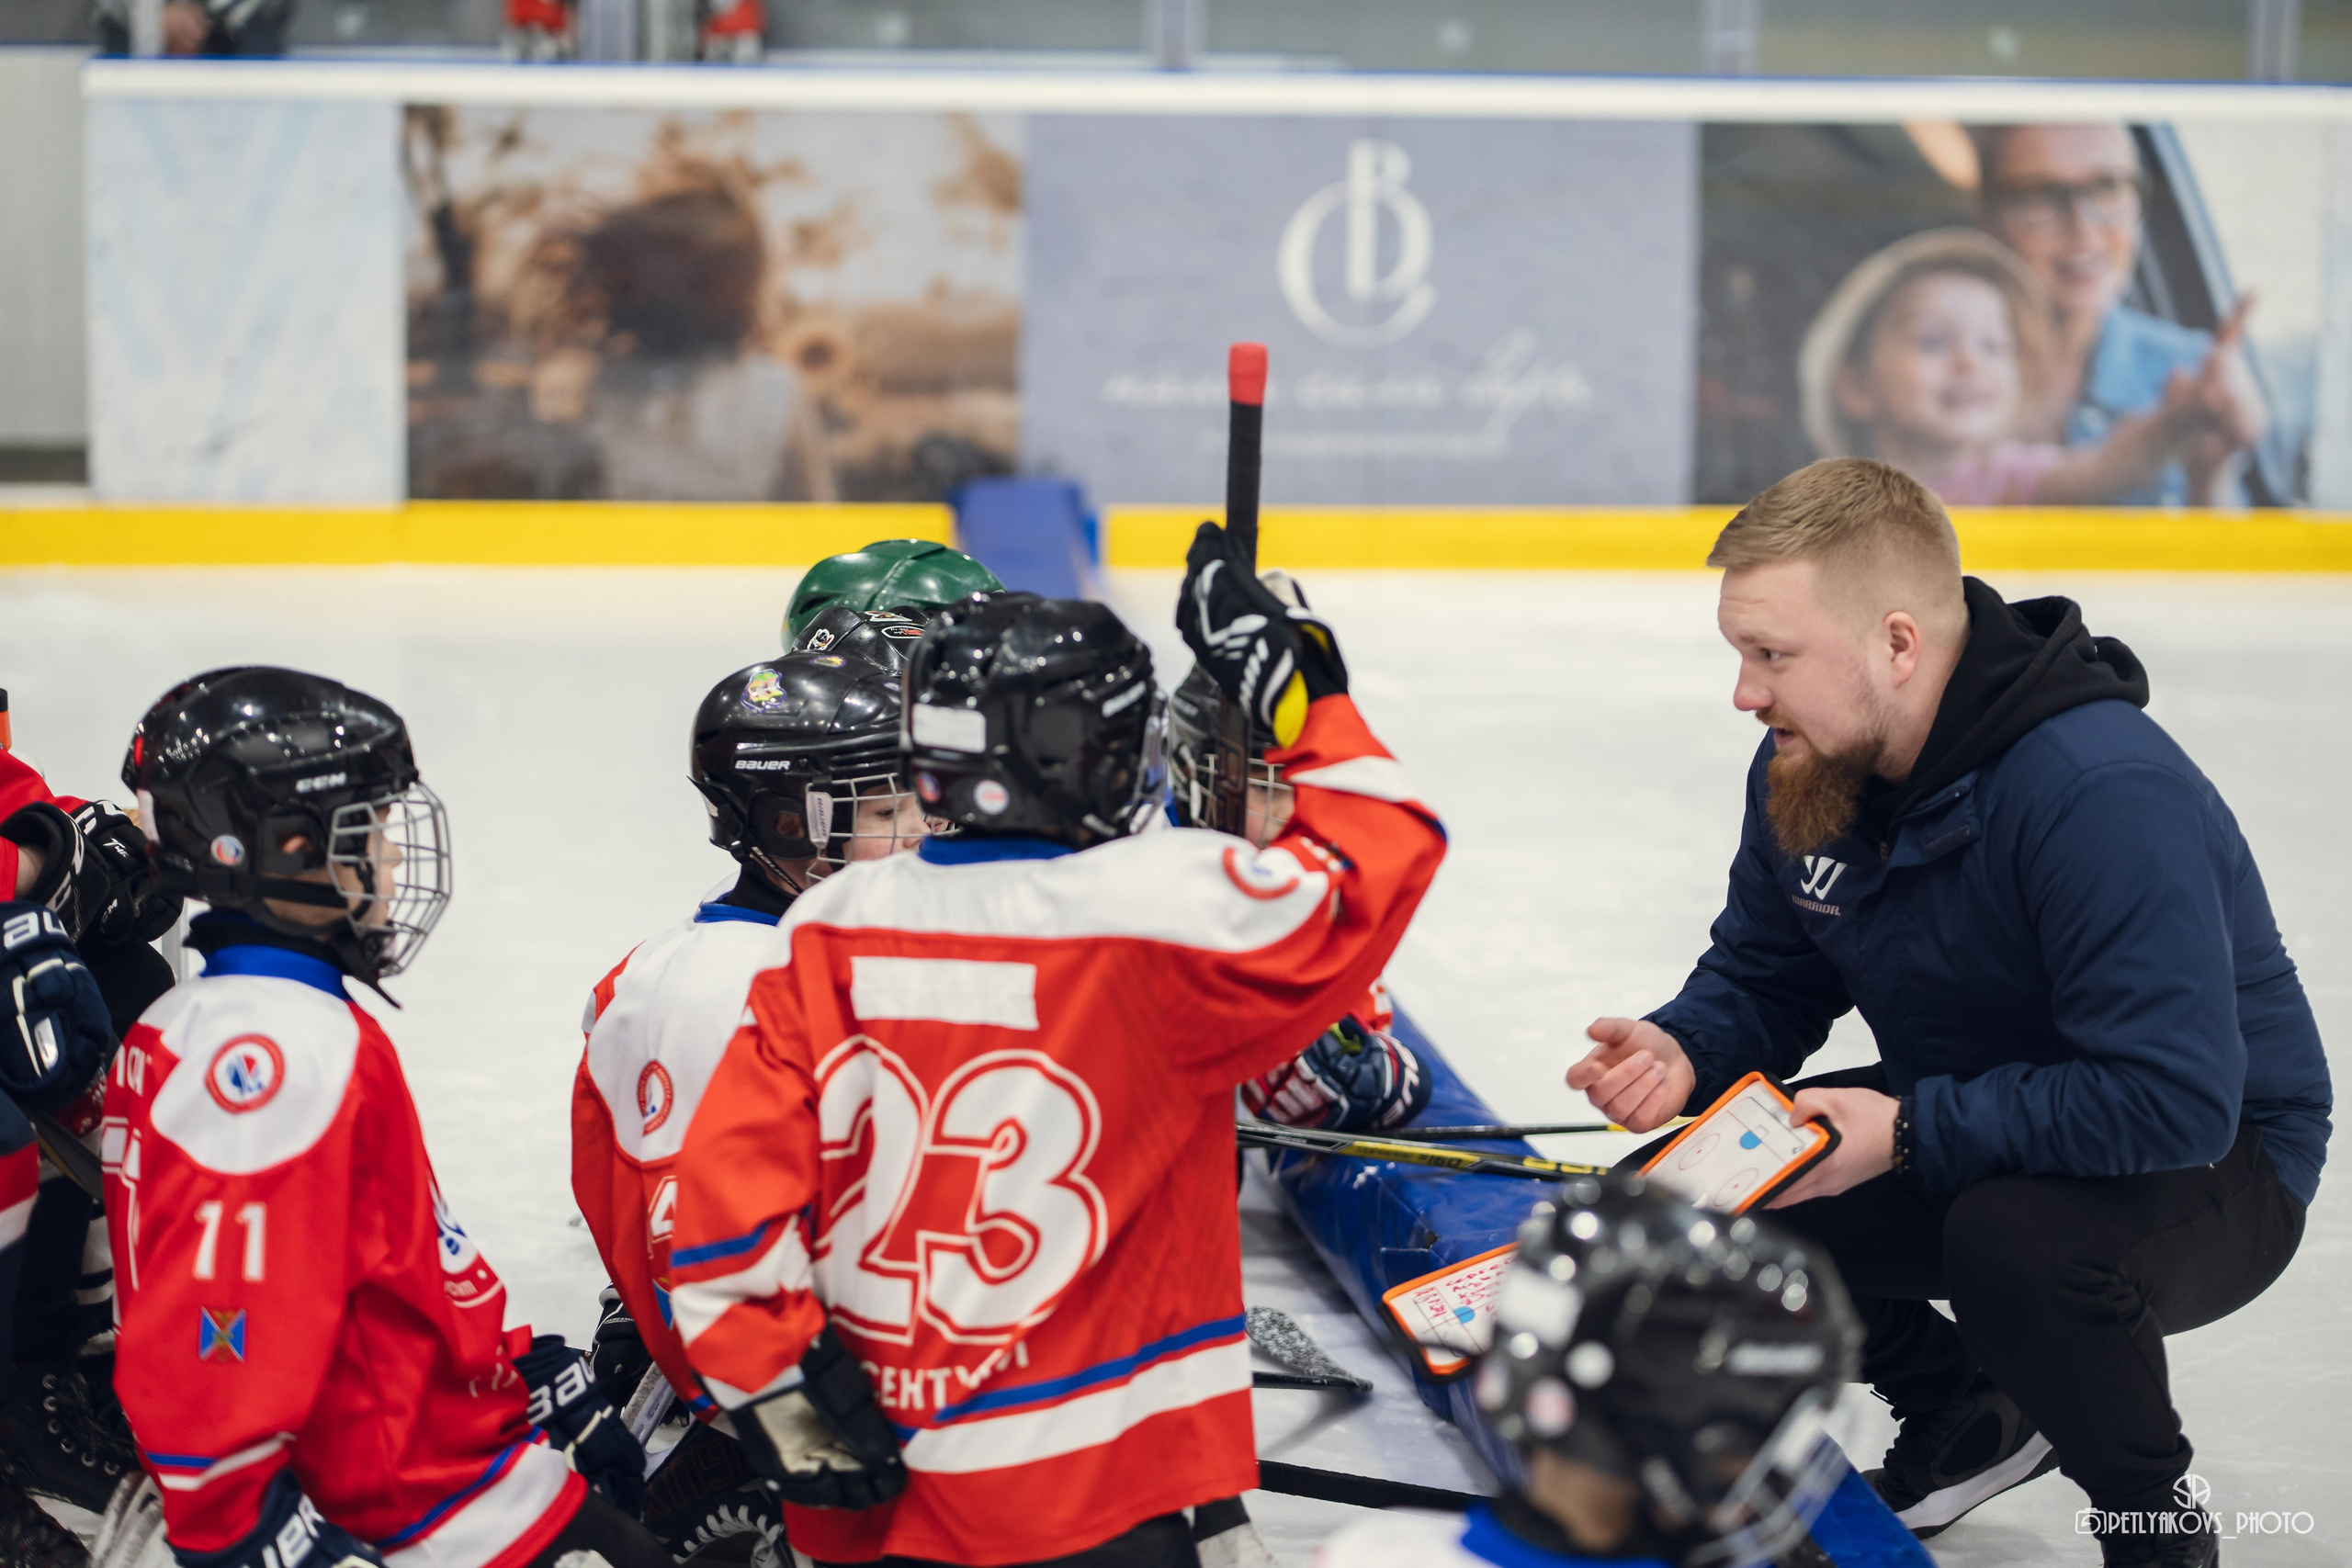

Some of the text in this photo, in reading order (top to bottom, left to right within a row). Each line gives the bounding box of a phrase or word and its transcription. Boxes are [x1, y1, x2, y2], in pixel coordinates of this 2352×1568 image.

[735, 760, 791, 771] BAUER
[814, 1033, 1108, 1347] 23
[191, 1200, 267, 1283] 11
